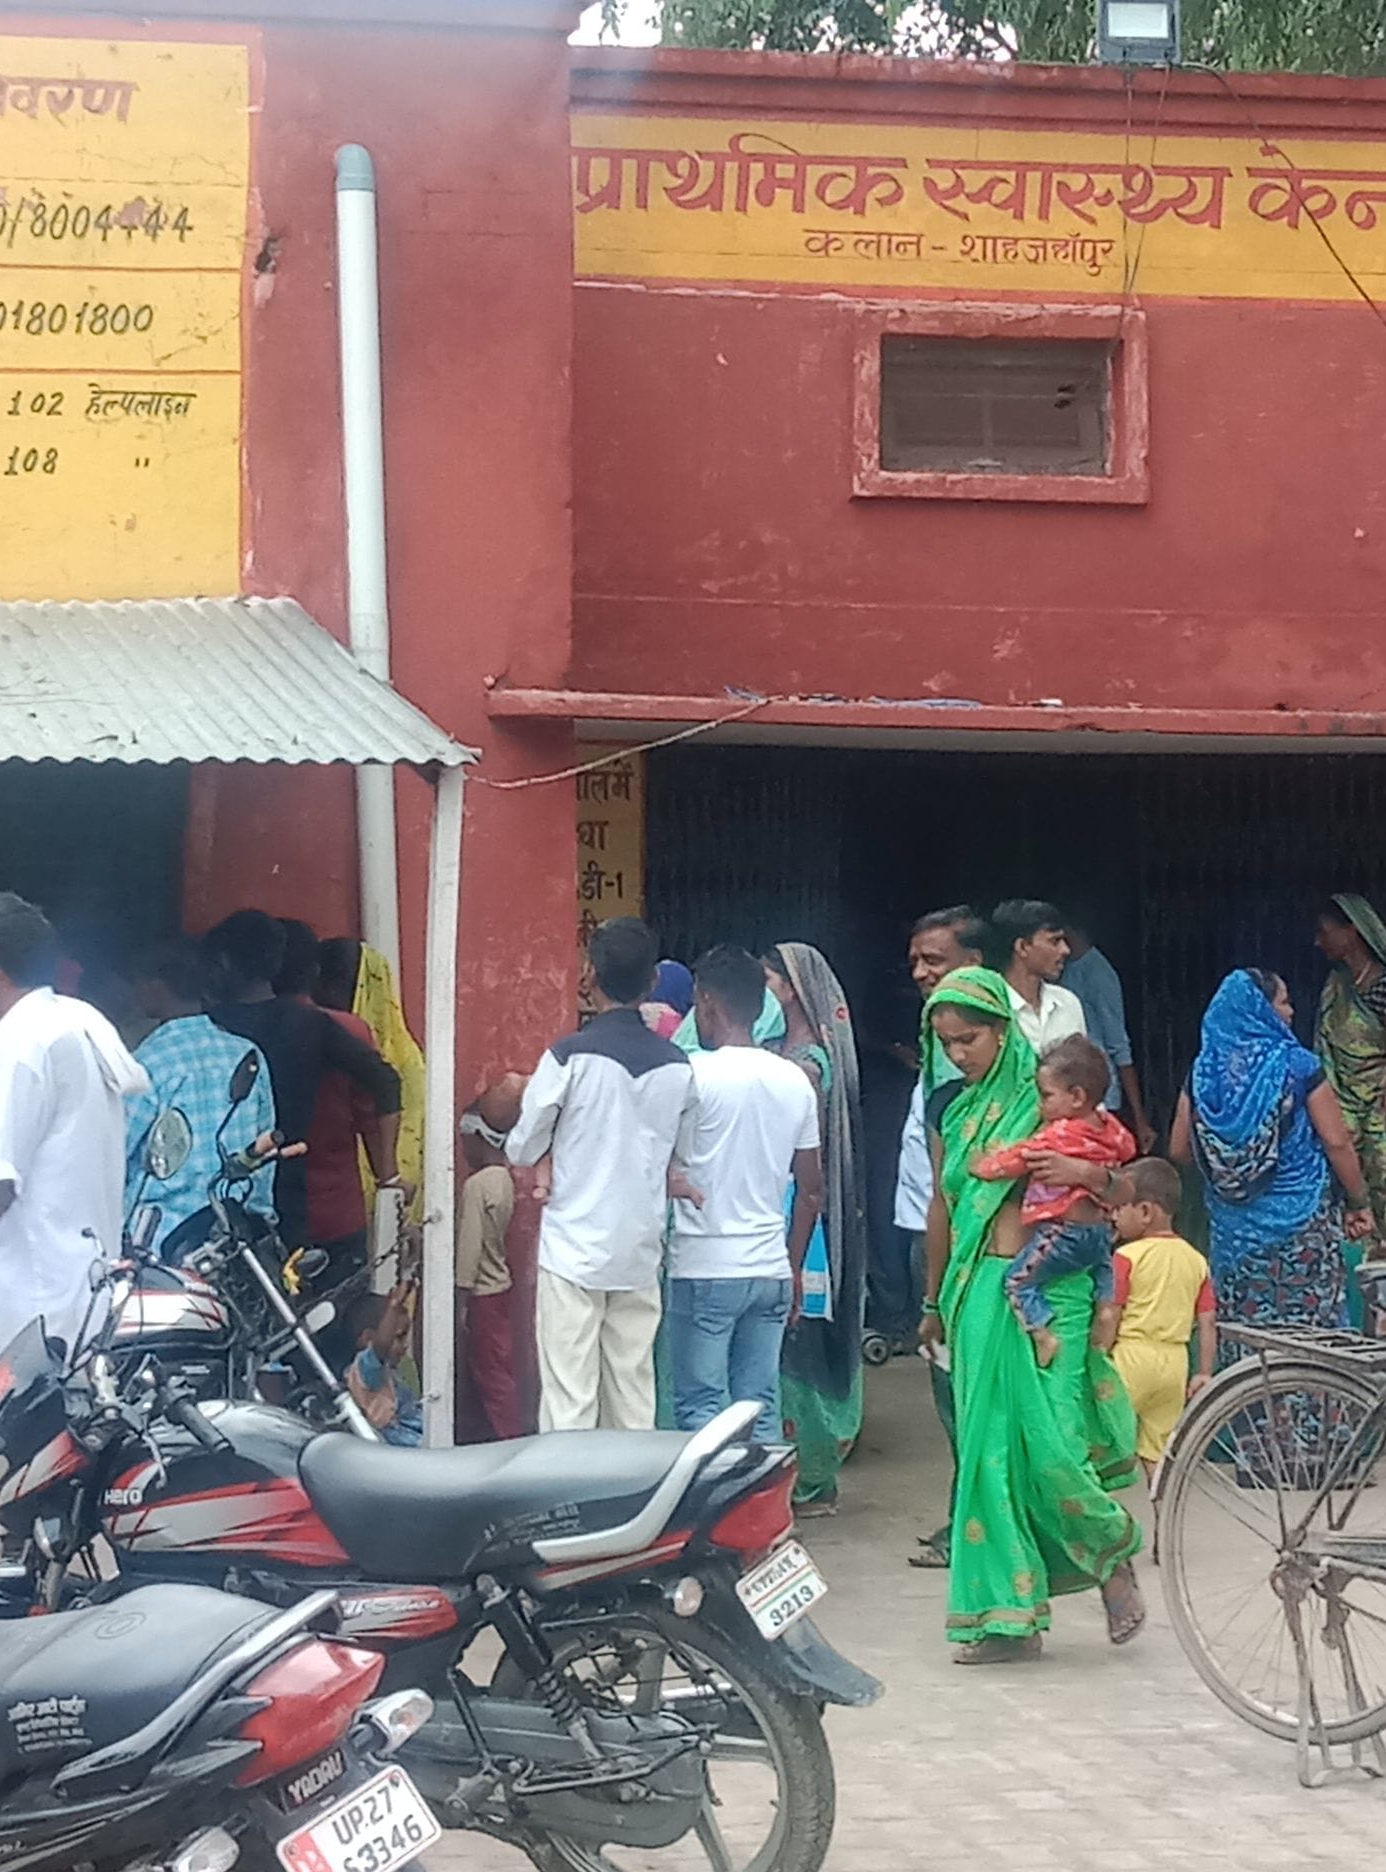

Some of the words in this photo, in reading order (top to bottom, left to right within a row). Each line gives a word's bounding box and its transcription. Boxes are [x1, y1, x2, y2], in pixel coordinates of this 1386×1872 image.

[571, 132, 908, 217] प्राथमिक
[923, 158, 1233, 229] स्वास्थ्य
[803, 229, 924, 262] कलान
[7, 390, 64, 417] 102
[84, 383, 198, 424] हेल्पलाइन
[4, 446, 59, 476] 108
[288, 1750, 344, 1804] YADAV
